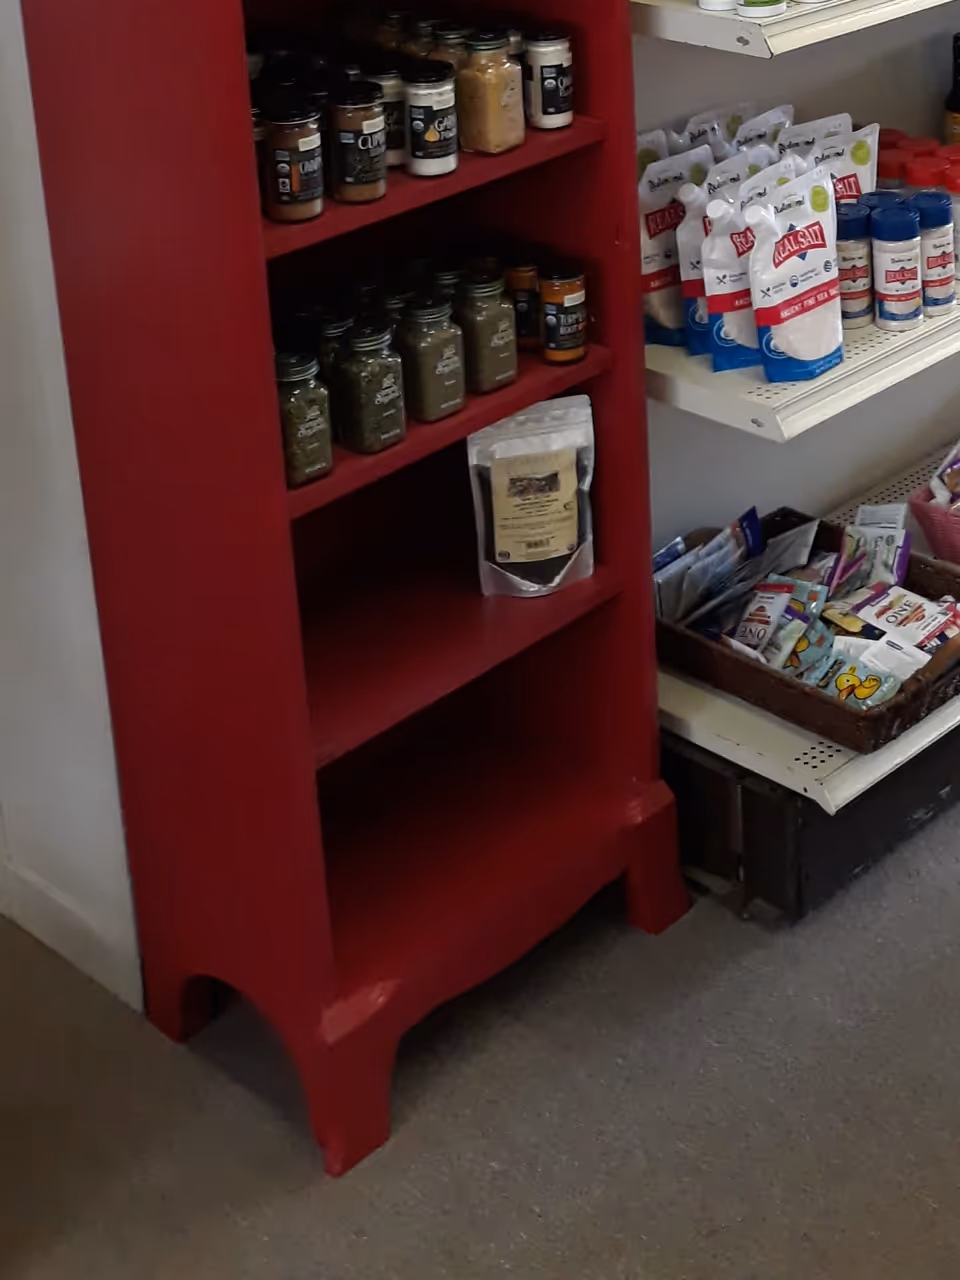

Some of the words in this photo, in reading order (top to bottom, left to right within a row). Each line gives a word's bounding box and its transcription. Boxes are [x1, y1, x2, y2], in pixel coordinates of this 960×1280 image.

[733, 231, 754, 254] REA
[774, 236, 798, 265] REAL
[798, 225, 824, 249] SALT
[885, 599, 915, 625] ONE
